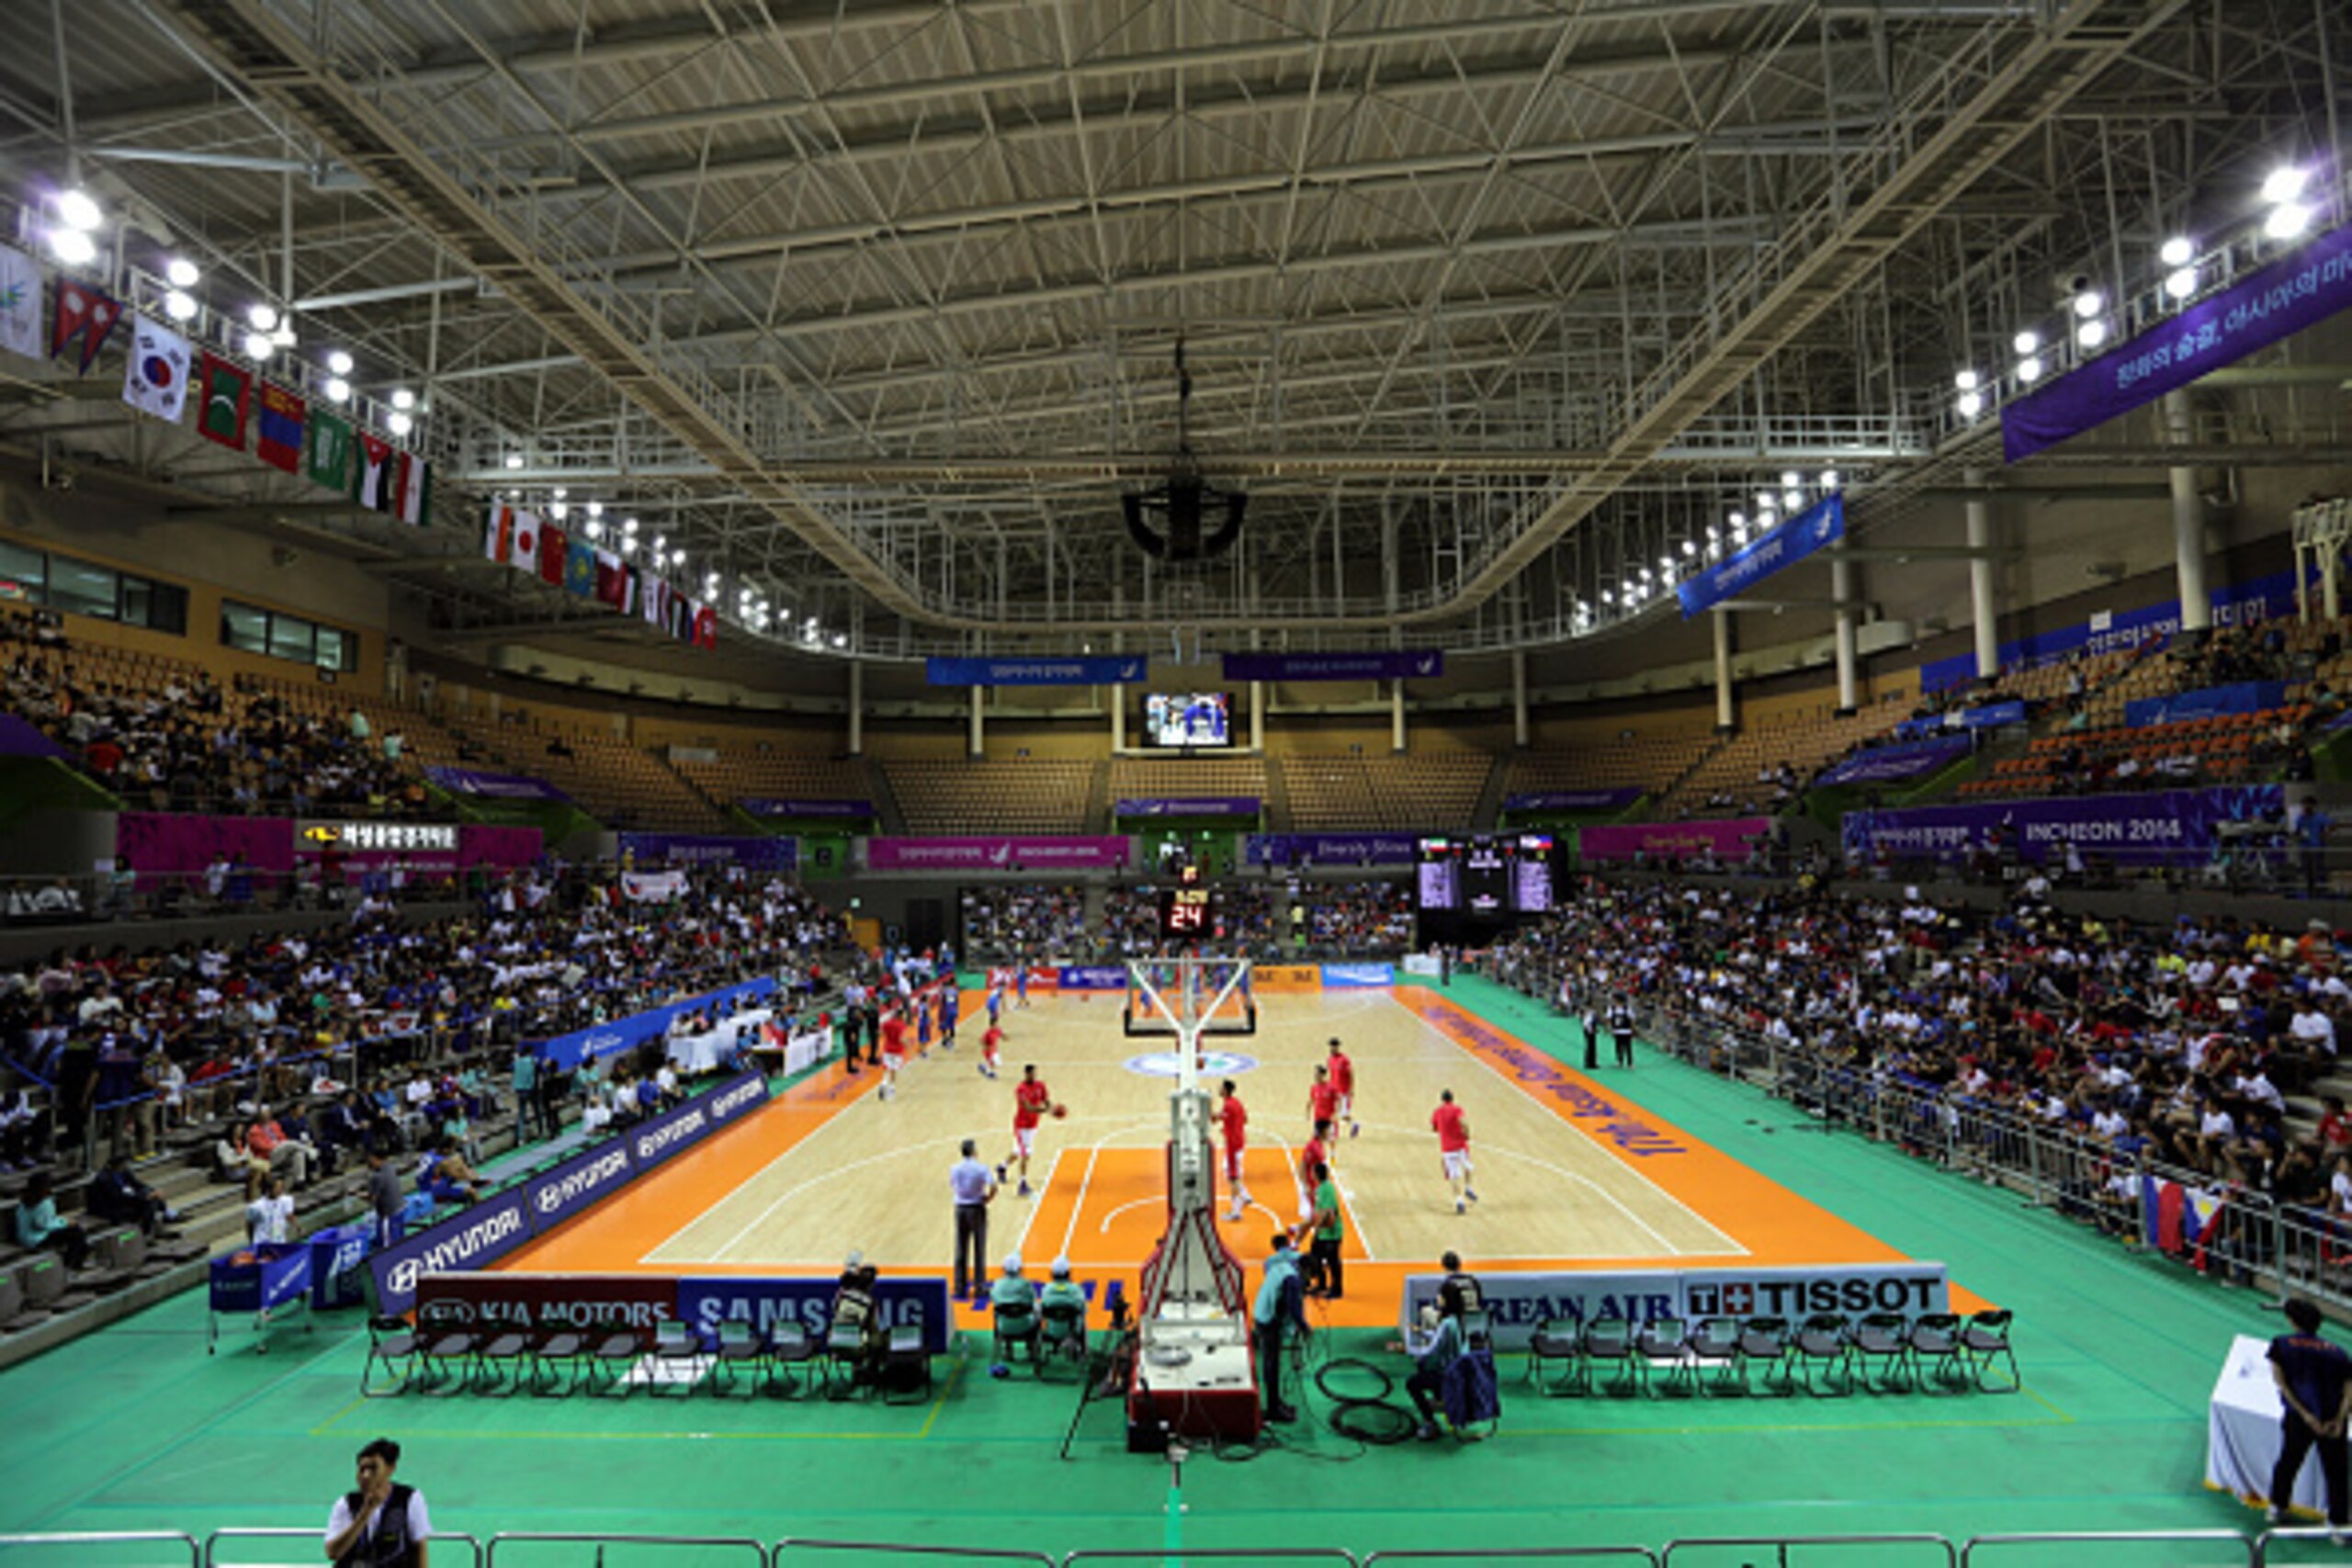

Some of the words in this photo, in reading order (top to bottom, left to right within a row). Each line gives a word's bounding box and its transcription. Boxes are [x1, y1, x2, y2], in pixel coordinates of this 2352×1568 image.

[2026, 820, 2122, 841] INCHEON
[2128, 818, 2182, 840] 2014
[1170, 905, 1201, 928] 24
[558, 1148, 630, 1201] HYUNDAI
[423, 1206, 523, 1272] HYUNDAI
[1600, 1293, 1672, 1322] AIR
[1758, 1278, 1940, 1314] TISSOT
[480, 1302, 528, 1323] KIA
[542, 1301, 670, 1325] MOTORS
[698, 1298, 924, 1334] SAMSNG
